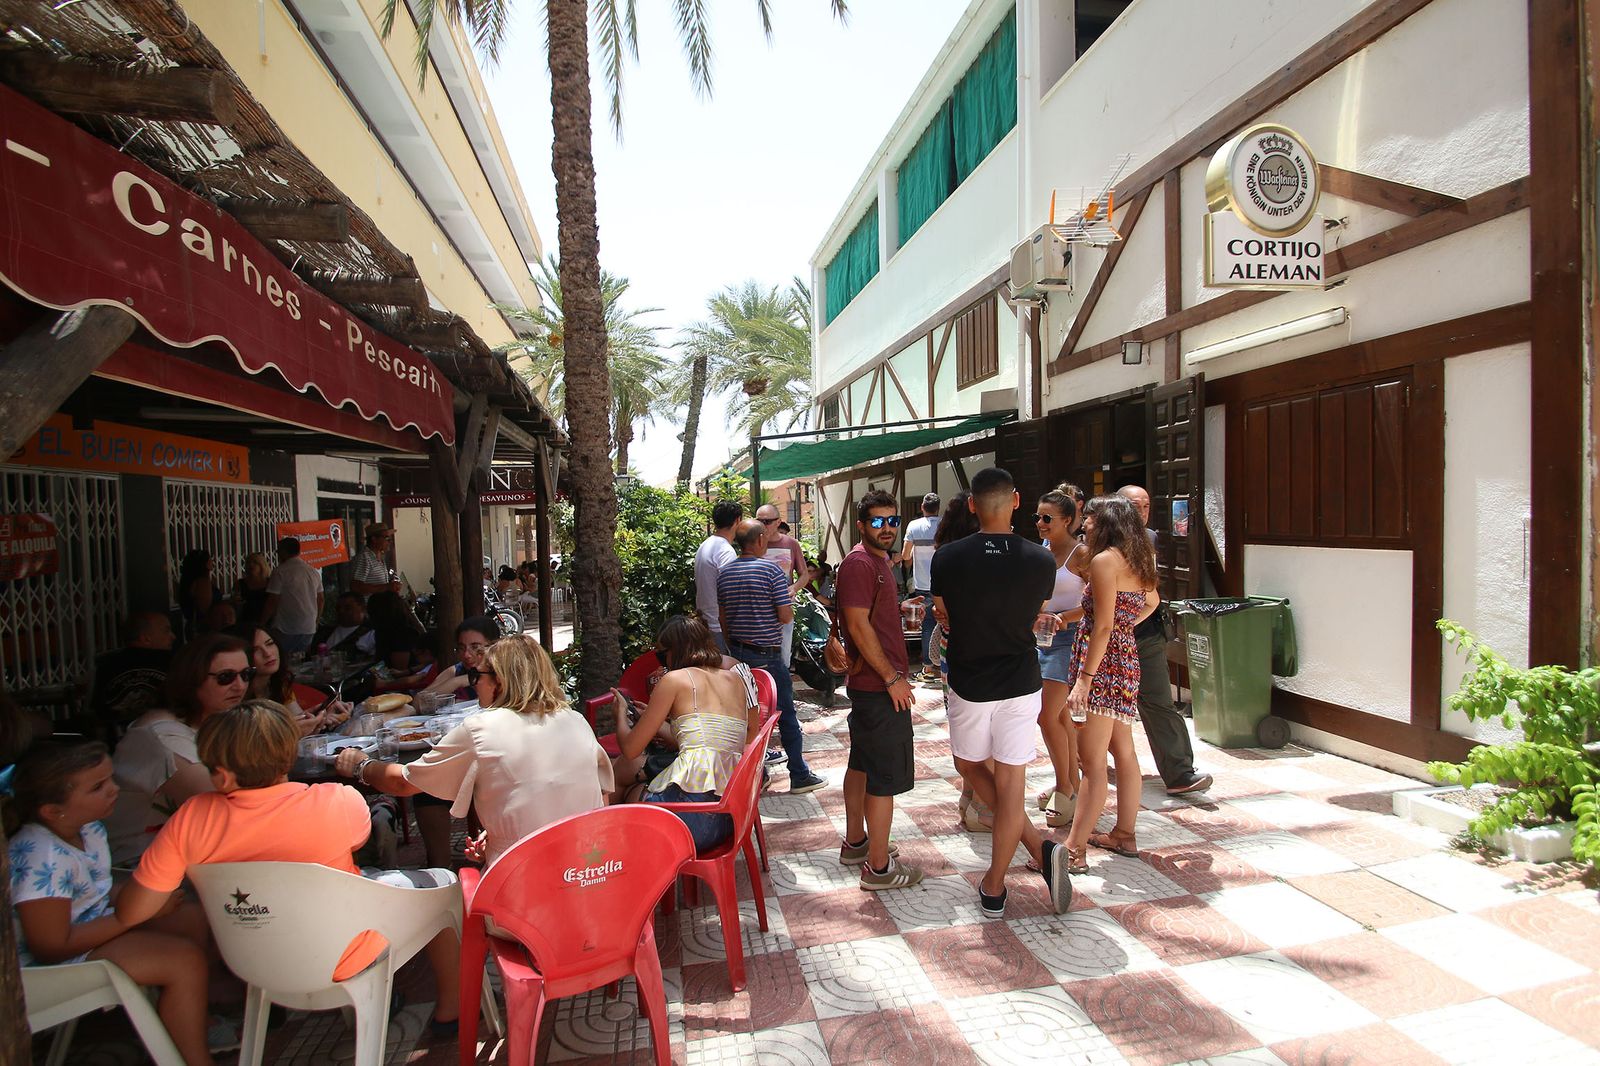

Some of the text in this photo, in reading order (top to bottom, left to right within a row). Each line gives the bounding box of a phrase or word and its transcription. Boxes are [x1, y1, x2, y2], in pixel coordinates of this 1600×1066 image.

[1246, 153, 1308, 216] EINE KÖNIGIN UNTER DEN BIEREN
[112, 170, 302, 321] Carnes
[1227, 239, 1321, 260] CORTIJO
[1228, 263, 1321, 281] ALEMAN
[39, 427, 73, 457] EL
[81, 432, 143, 466] BUEN
[152, 442, 213, 473] COMER
[11, 536, 56, 556] ALQUILA
[563, 859, 623, 883] Estrella
[580, 876, 606, 888] Damm
[224, 903, 270, 915] Estrella
